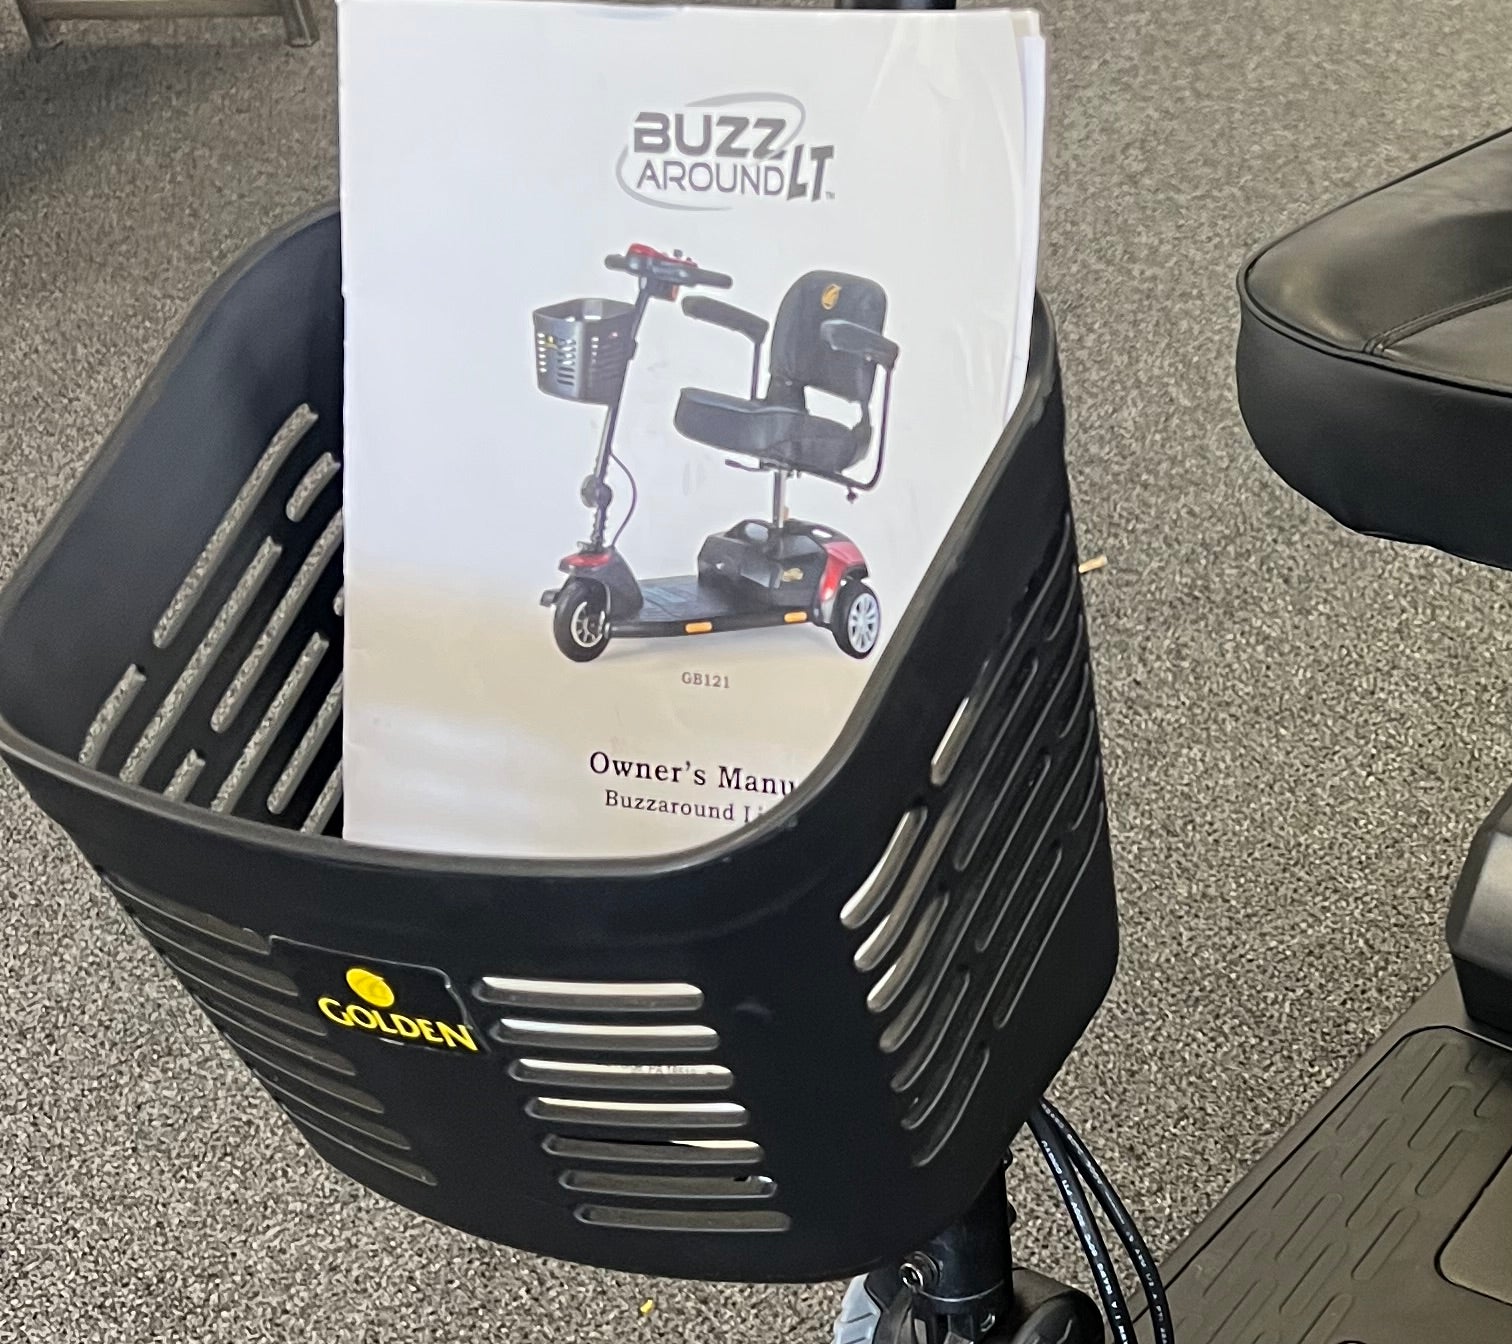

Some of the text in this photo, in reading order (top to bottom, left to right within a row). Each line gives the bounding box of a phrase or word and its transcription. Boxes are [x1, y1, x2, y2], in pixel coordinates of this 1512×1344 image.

[633, 111, 787, 160] BUZZ
[636, 159, 785, 196] AROUND
[681, 671, 730, 689] GB121
[589, 750, 707, 787] Owner's
[604, 788, 735, 822] Buzzaround
[318, 996, 479, 1052] GOLDEN
